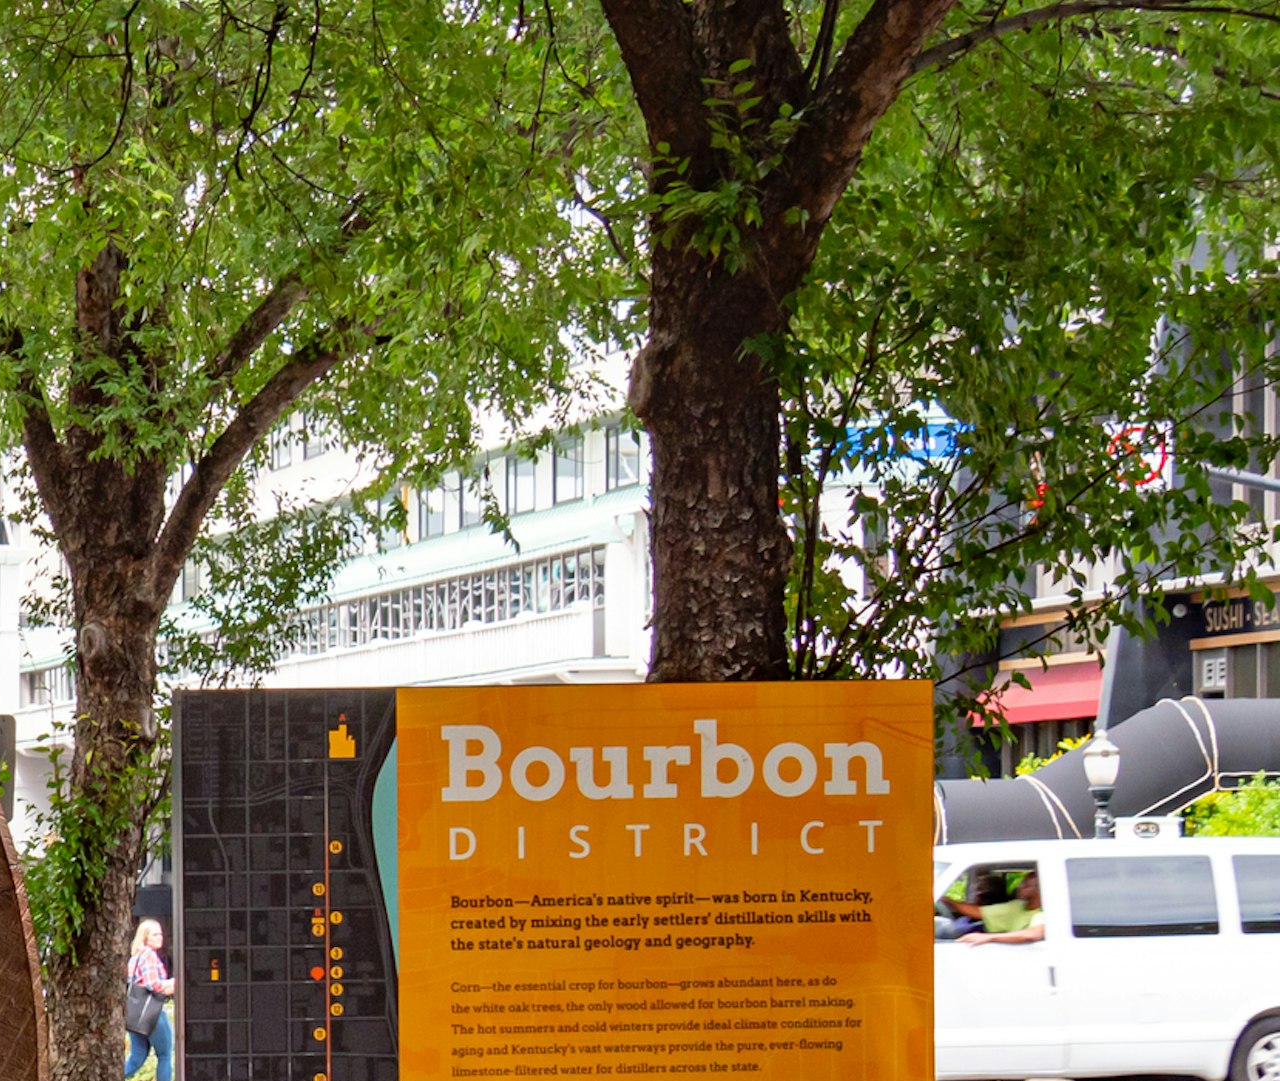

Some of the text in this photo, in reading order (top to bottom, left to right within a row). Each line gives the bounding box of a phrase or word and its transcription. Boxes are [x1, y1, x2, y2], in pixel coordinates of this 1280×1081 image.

[1205, 603, 1244, 632] SUSHI
[441, 719, 890, 801] Bourbon
[449, 820, 883, 861] DISTRICT
[451, 889, 873, 908] Bourbon—America's native spirit—was born in Kentucky,
[450, 910, 872, 932] created by mixing the early settlers' distillation skills with
[450, 933, 755, 952] the state's natural geology and geography.
[451, 976, 838, 992] Corn—the essential crop for bourbon—grows abundant here, as do
[451, 996, 856, 1014] the white oak trees, the only wood allowed for bourbon barrel making.
[451, 1017, 862, 1034] The hot summers and cold winters provide ideal climate conditions for
[451, 1038, 843, 1058] aging and Kentucky's vast waterways provide the pure, ever-flowing
[452, 1061, 762, 1077] limestone-filtered water for distillers across the state.
